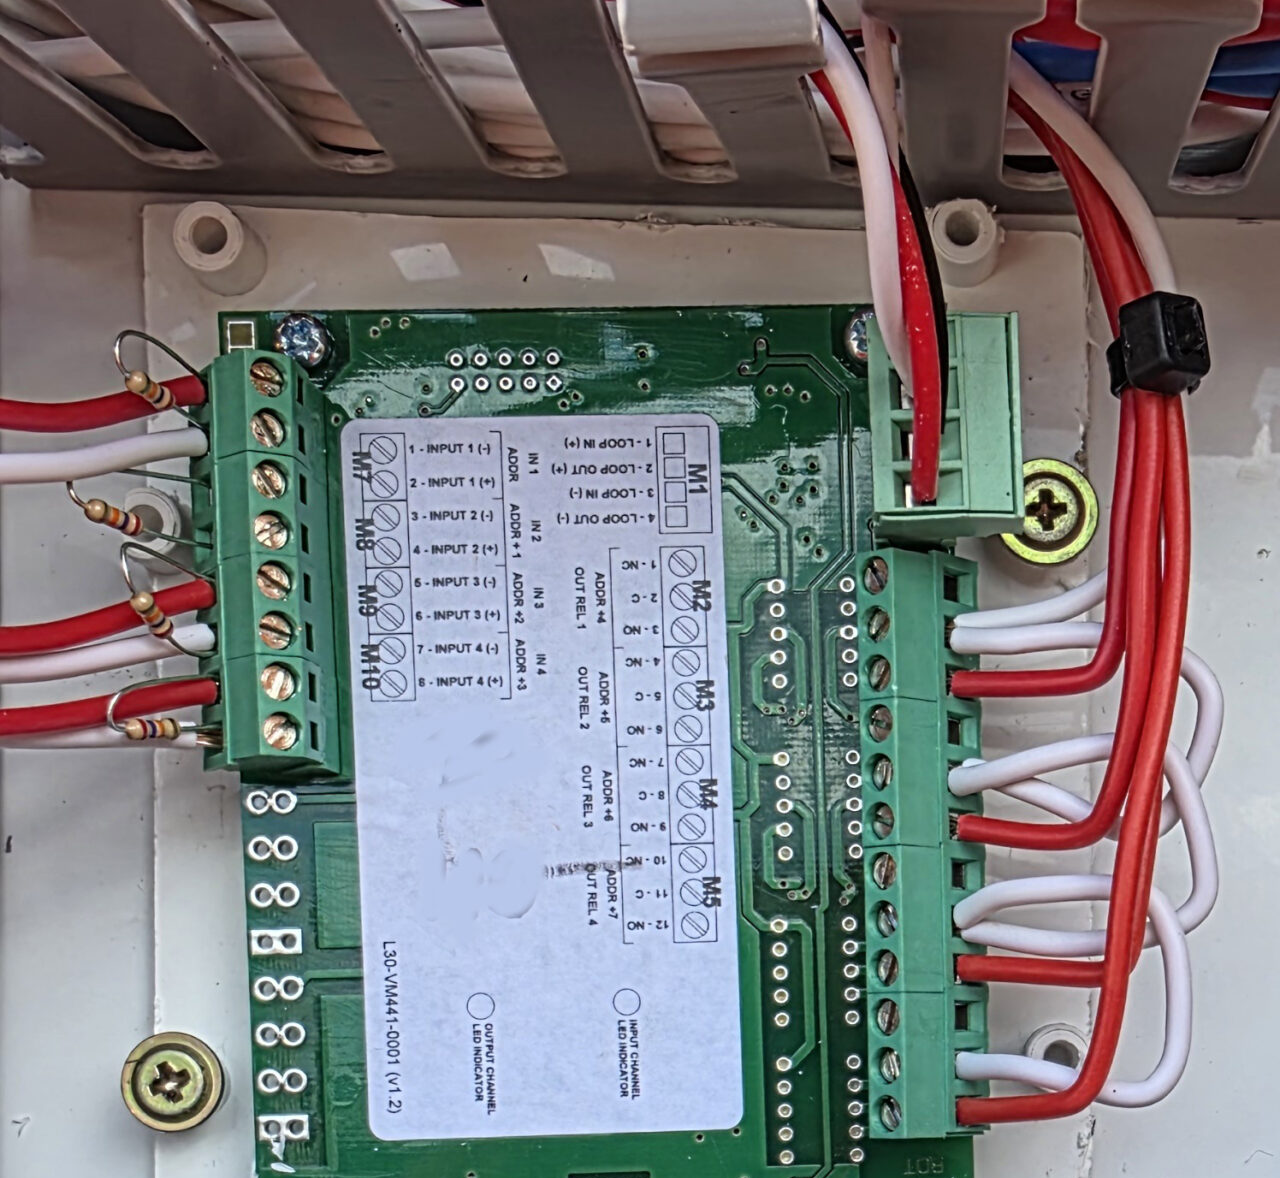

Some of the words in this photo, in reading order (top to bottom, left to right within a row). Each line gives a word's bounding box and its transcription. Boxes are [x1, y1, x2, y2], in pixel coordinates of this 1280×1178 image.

[426, 443, 464, 454] INPUT
[477, 443, 491, 456] (-)
[563, 436, 581, 450] (+)
[583, 438, 596, 449] IN
[598, 437, 635, 449] LOOP
[352, 451, 373, 484] M7
[506, 446, 520, 483] ADDR
[527, 452, 539, 465] IN
[551, 462, 568, 476] (+)
[599, 463, 636, 475] LOOP
[570, 464, 598, 476] OUT
[688, 463, 708, 494] M1
[409, 477, 418, 489] 2
[427, 476, 466, 488] INPUT
[479, 476, 496, 490] (+)
[568, 486, 583, 500] (-)
[585, 488, 599, 500] IN
[601, 487, 637, 499] LOOP
[646, 487, 655, 499] 3
[429, 510, 467, 521] INPUT
[480, 509, 494, 523] (-)
[509, 503, 522, 540] ADDR
[530, 519, 542, 533] IN
[556, 512, 570, 525] (-)
[573, 513, 600, 525] OUT
[602, 513, 638, 525] LOOP
[355, 518, 374, 551] M8
[431, 543, 469, 555] INPUT
[471, 543, 480, 555] 2
[482, 543, 499, 557] (+)
[431, 576, 470, 588] INPUT
[482, 576, 497, 589] (-)
[512, 571, 525, 608] ADDR
[574, 566, 586, 594] OUT
[594, 571, 607, 608] ADDR
[358, 584, 378, 618] M9
[533, 587, 545, 600] IN
[692, 580, 712, 612] M2
[433, 609, 471, 621] INPUT
[484, 609, 501, 622] (+)
[514, 610, 525, 624] +2
[575, 596, 587, 621] REL
[596, 609, 607, 624] +4
[434, 643, 473, 654] INPUT
[485, 642, 499, 656] (-)
[514, 638, 527, 674] ADDR
[535, 653, 547, 666] IN
[361, 643, 381, 690] M10
[536, 667, 548, 676] 4
[436, 675, 474, 687] INPUT
[487, 675, 504, 688] (+)
[516, 676, 528, 691] +3
[577, 666, 589, 693] OUT
[598, 671, 610, 706] ADDR
[696, 679, 715, 711] M3
[578, 695, 590, 720] REL
[581, 764, 593, 791] OUT
[602, 769, 614, 806] ADDR
[701, 778, 718, 810] M4
[582, 793, 594, 819] REL
[609, 869, 618, 905] ADDR
[704, 876, 722, 908] M5
[587, 892, 598, 916] REL
[607, 906, 619, 920] +7
[382, 941, 403, 1068] L30-VM441-0001
[472, 1023, 482, 1044] LED
[617, 1019, 628, 1040] LED
[628, 1019, 639, 1048] INPUT
[484, 1022, 495, 1064] OUTPUT
[473, 1046, 484, 1102] INDICATOR
[618, 1042, 629, 1098] INDICATOR
[630, 1051, 641, 1101] CHANNEL
[387, 1073, 403, 1114] (v1.2)
[485, 1066, 497, 1116] CHANNEL
